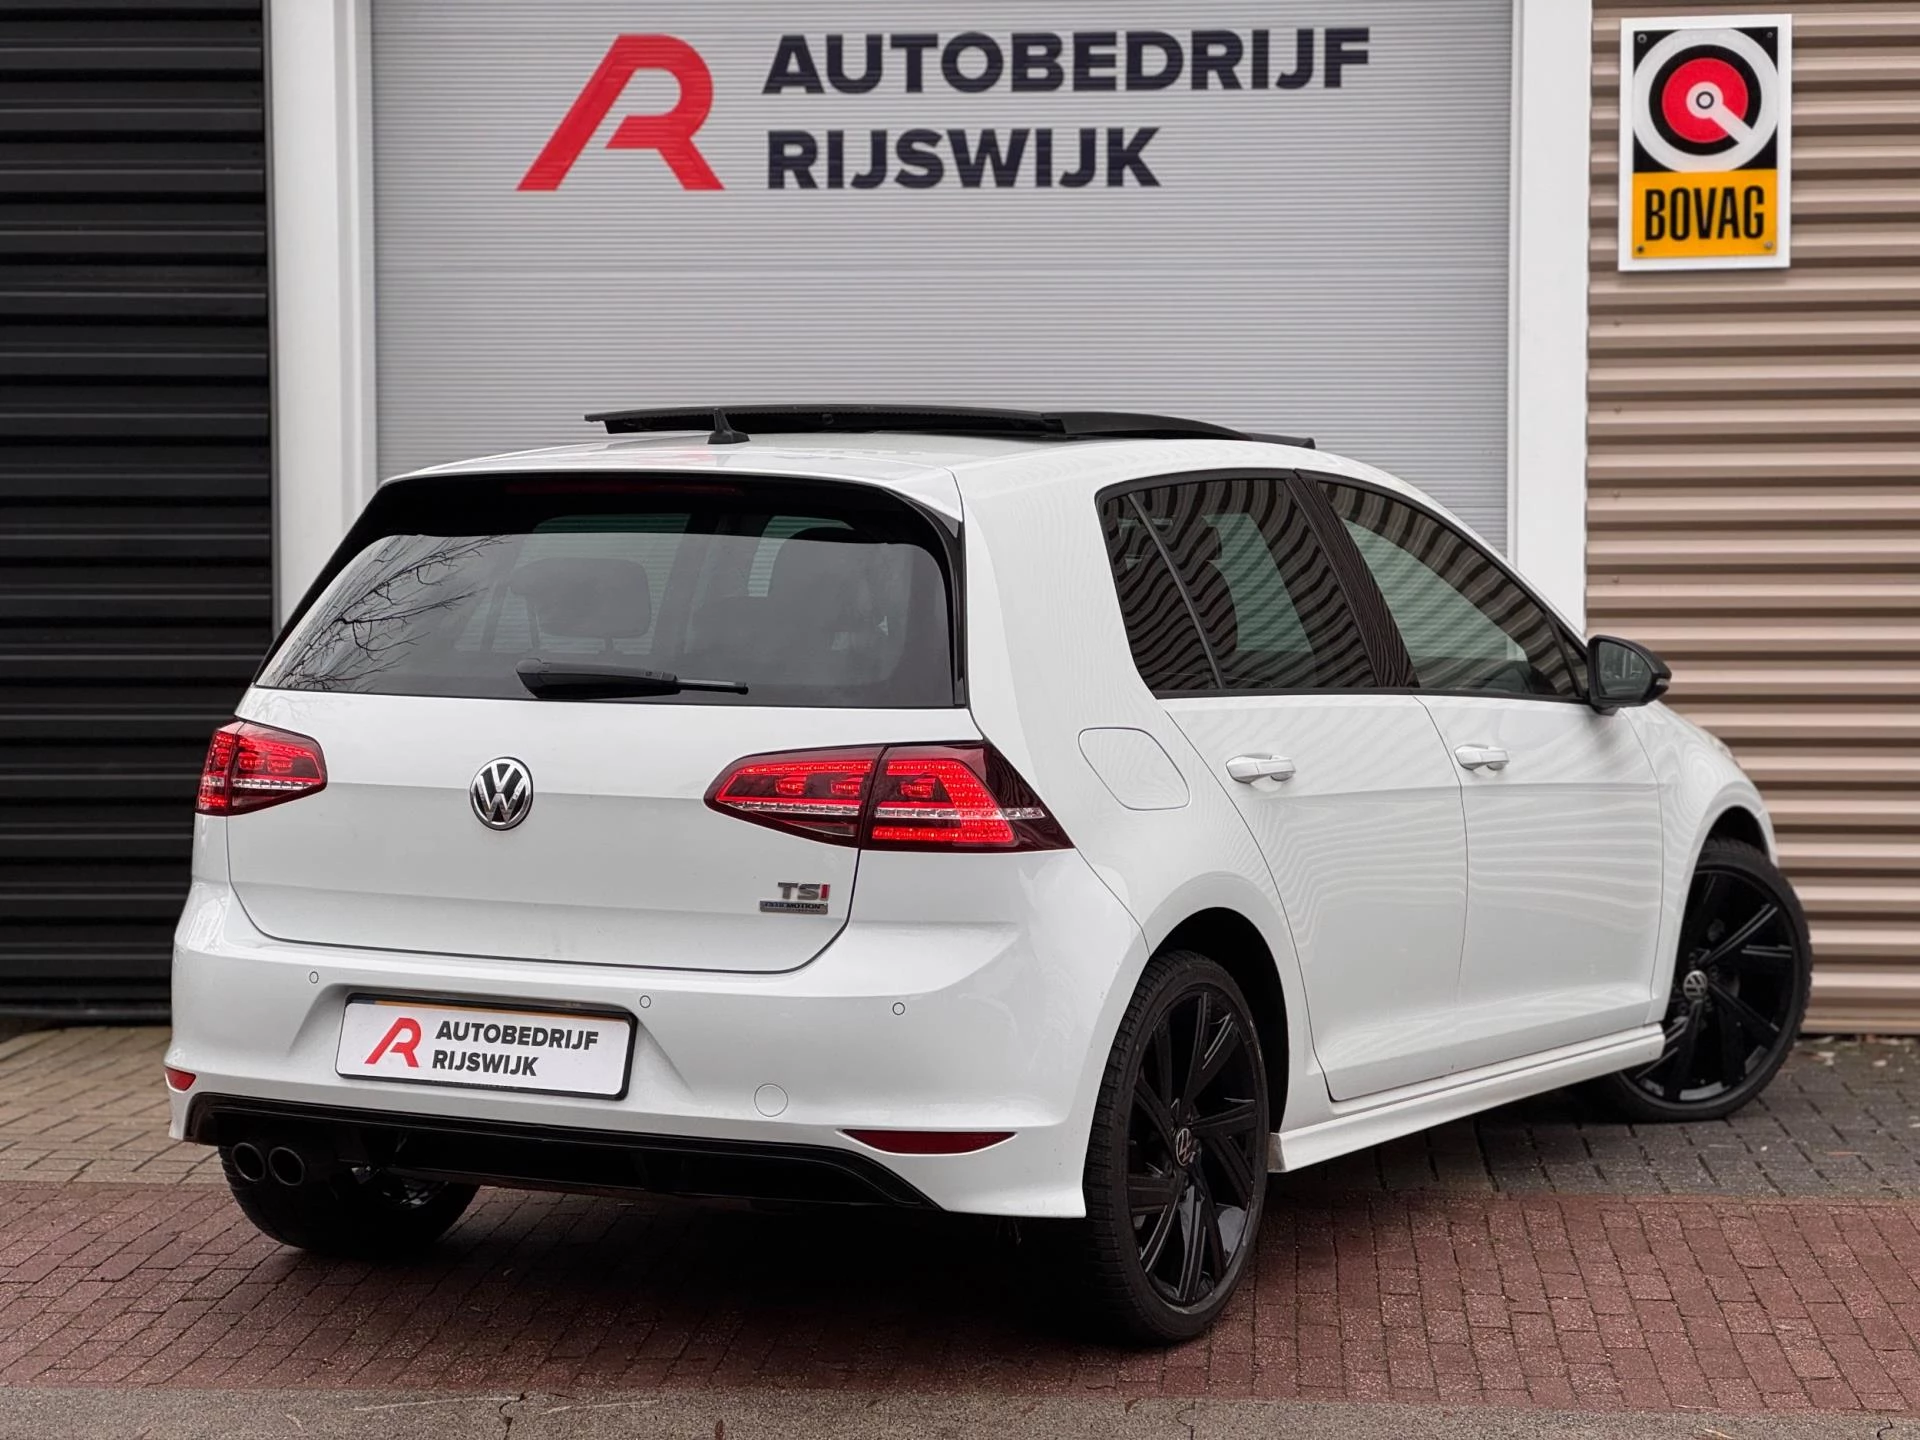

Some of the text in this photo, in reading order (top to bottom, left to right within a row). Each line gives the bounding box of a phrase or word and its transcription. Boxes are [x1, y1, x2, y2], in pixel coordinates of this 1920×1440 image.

[763, 27, 1370, 95] AUTOBEDRIJF
[767, 127, 1161, 190] RIJSWIJK
[1645, 185, 1765, 242] BOVAG
[432, 1049, 539, 1077] RIJSWIJK
[435, 1020, 599, 1051] AUTOBEDRIJF
